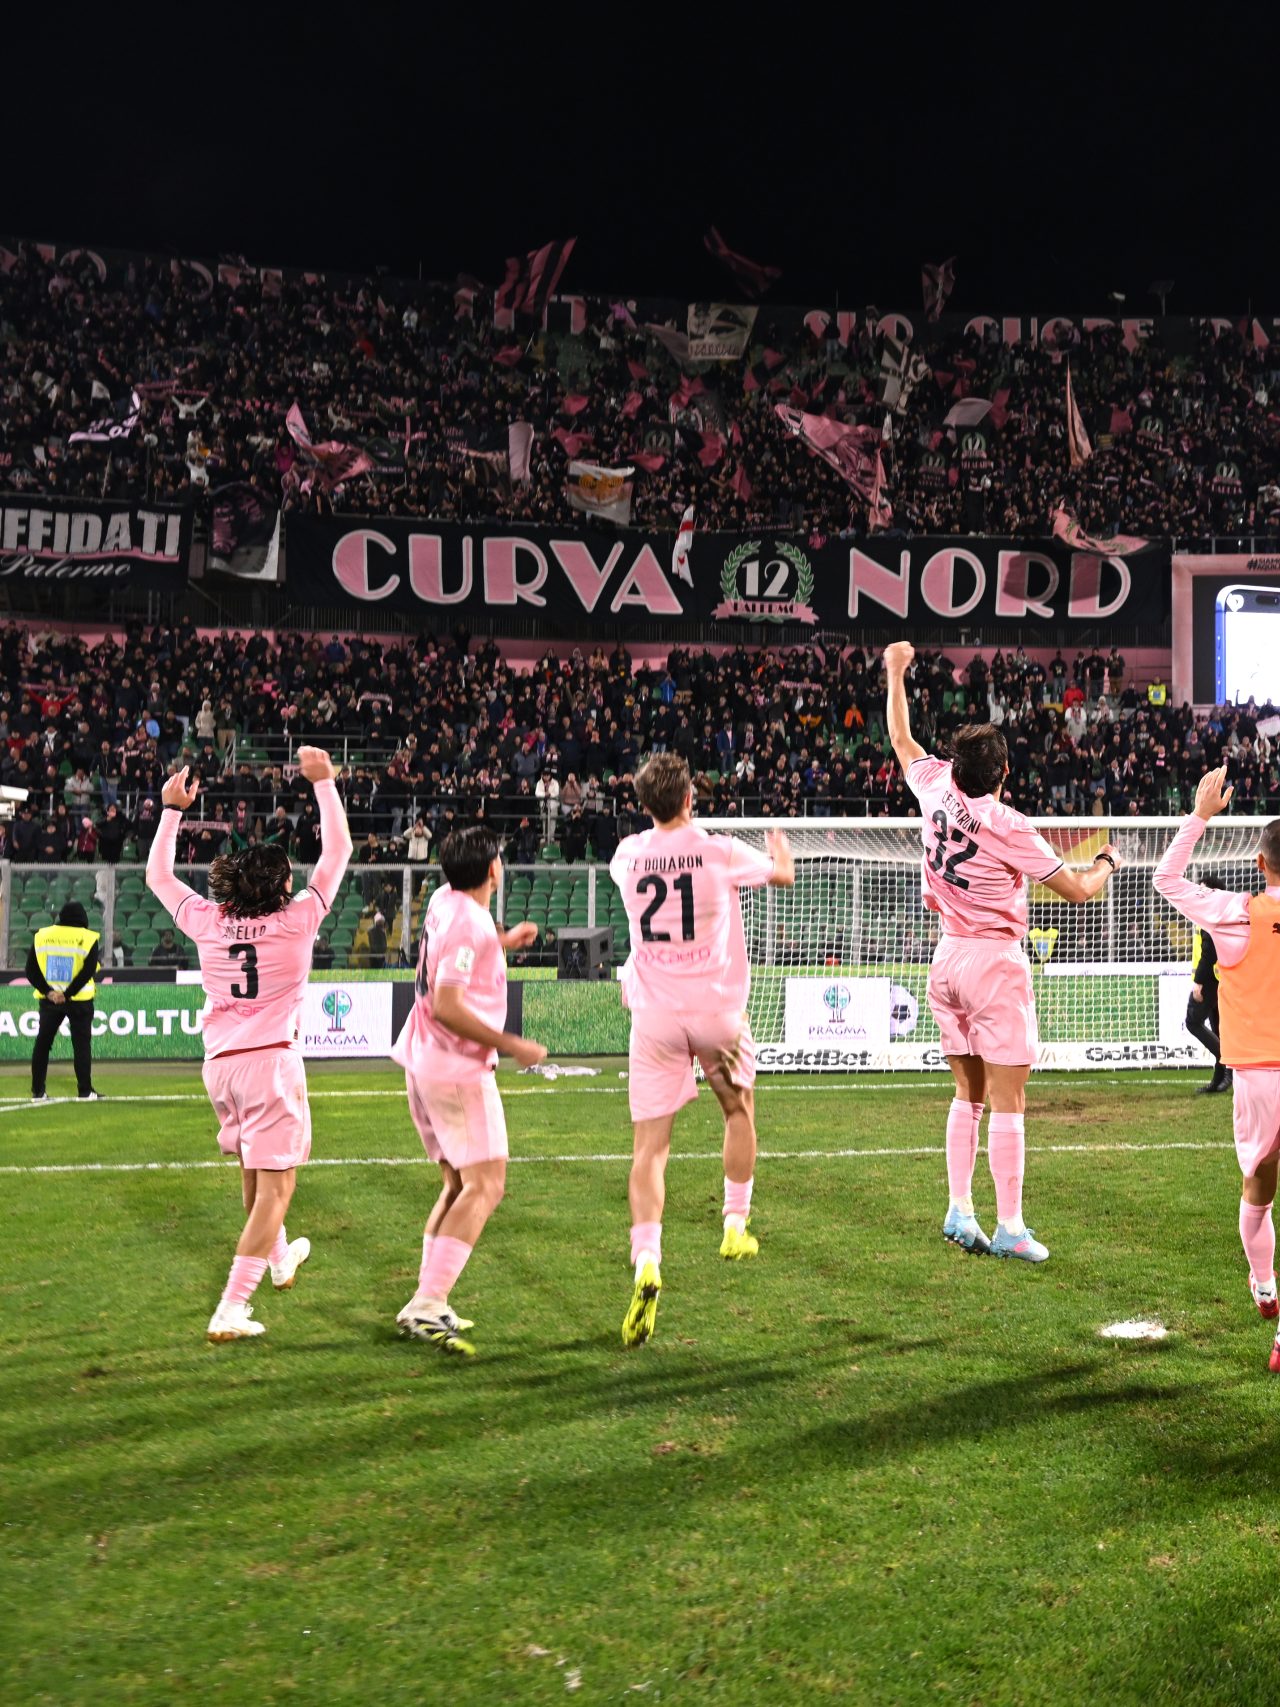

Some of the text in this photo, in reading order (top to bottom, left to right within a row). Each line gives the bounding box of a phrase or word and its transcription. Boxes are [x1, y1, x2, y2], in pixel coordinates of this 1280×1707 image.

[0, 508, 181, 556] FFIDATI
[332, 528, 1132, 619] CURVA NORD
[742, 560, 789, 597] 12
[941, 790, 981, 834] CECCARONI
[644, 854, 703, 872] DOUARON
[925, 809, 979, 890] 32
[636, 872, 695, 943] 21
[228, 943, 258, 999] 3
[305, 1034, 369, 1046] PRAGMA
[809, 1024, 867, 1035] PRAGMA
[756, 1048, 872, 1067] GoldBet
[1086, 1044, 1199, 1062] GoldBet
